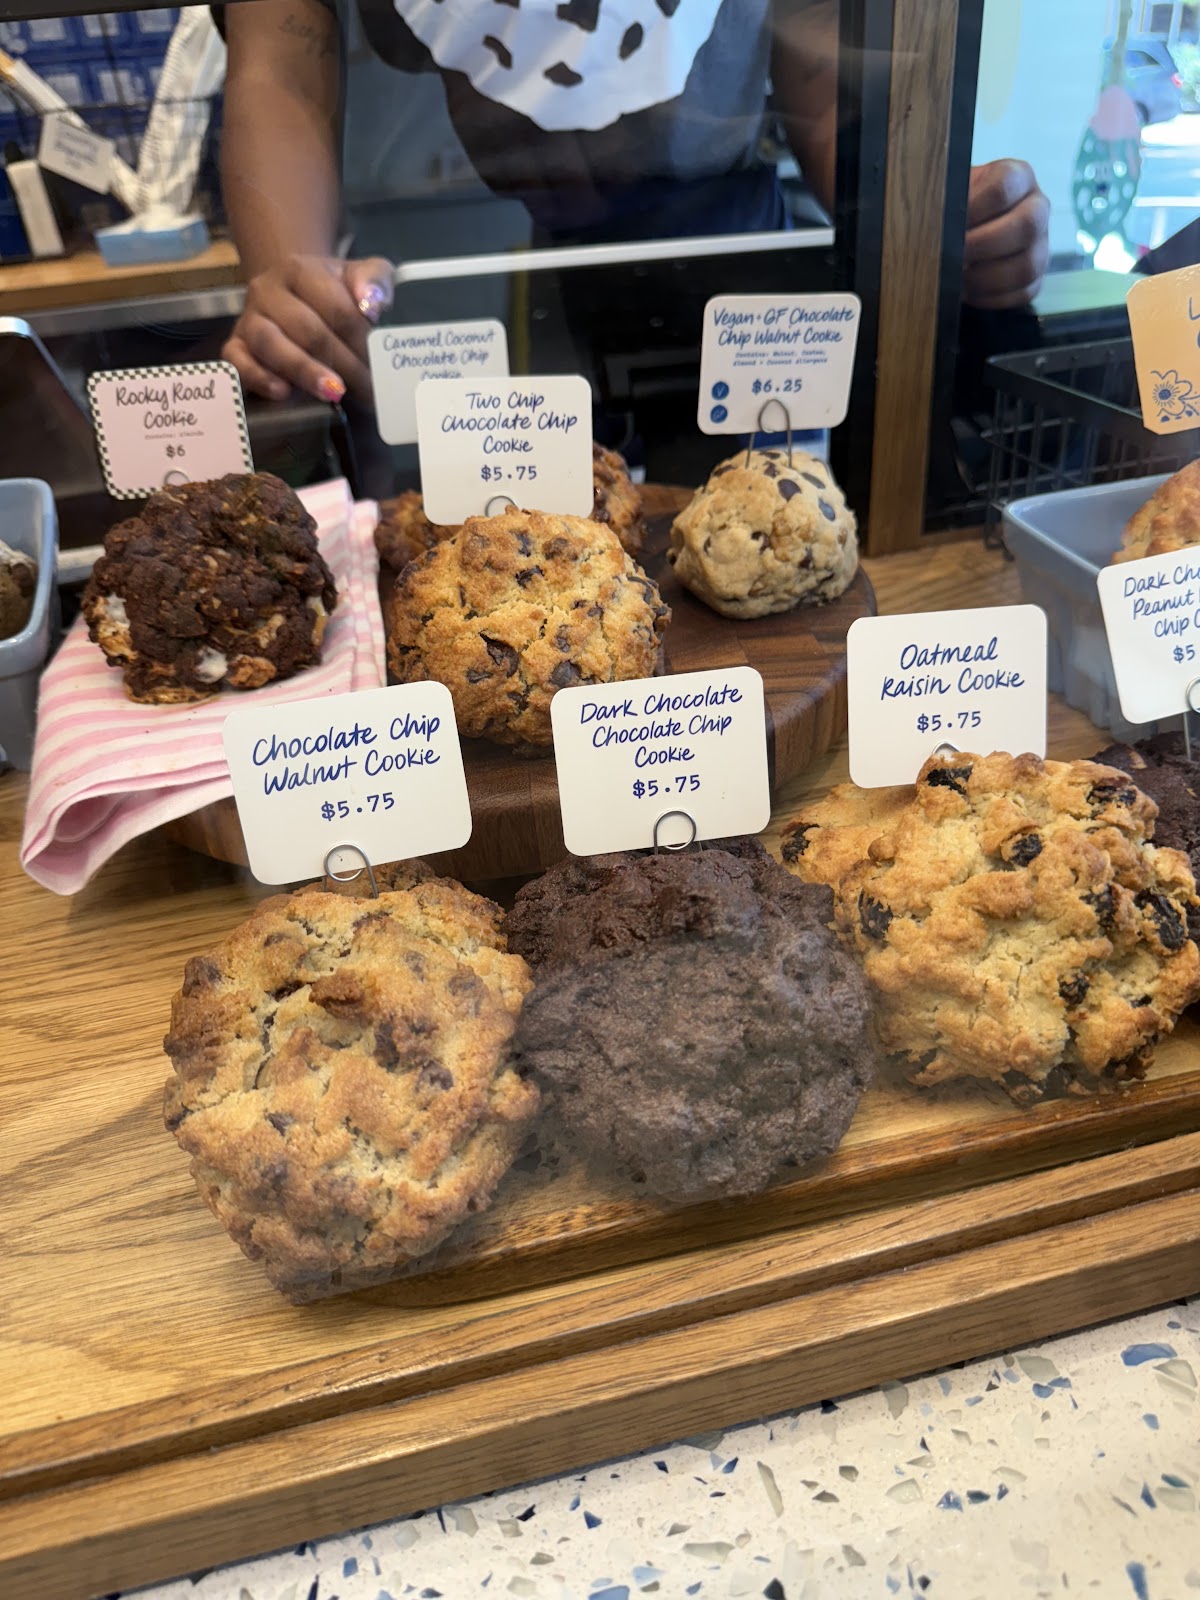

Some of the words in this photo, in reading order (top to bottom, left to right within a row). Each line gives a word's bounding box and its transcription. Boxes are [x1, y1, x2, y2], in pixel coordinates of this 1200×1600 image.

[714, 308, 754, 328] Vegan
[764, 307, 788, 325] GF
[788, 306, 854, 326] Chocolate
[382, 332, 444, 352] Caramel
[445, 327, 496, 348] Coconut
[718, 329, 751, 350] Chip
[754, 328, 801, 344] Walnut
[803, 326, 843, 344] Cookie
[392, 351, 458, 370] Chocolate
[460, 349, 490, 367] Chip
[116, 385, 169, 411] Rocky
[172, 379, 216, 403] Road
[752, 378, 803, 396] $6.25
[465, 392, 501, 410] Two
[507, 390, 545, 414] Chip
[144, 410, 198, 430] Cookie
[441, 414, 532, 433] Chocolate
[536, 412, 578, 434] Chip
[166, 444, 186, 459] $6
[482, 435, 534, 455] Cookie
[480, 464, 538, 482] $5.75
[1123, 570, 1170, 599] Dark
[1132, 588, 1195, 621] Peanut
[1154, 615, 1190, 638] Chip
[900, 636, 998, 670] Oatmeal
[880, 674, 951, 701] Raisin
[957, 667, 1025, 694] Cookie
[580, 699, 638, 725] Dark
[643, 684, 743, 716] Chocolate
[592, 717, 685, 749] Chocolate
[688, 714, 733, 737] Chip
[916, 710, 982, 734] $5.75
[252, 722, 378, 767] Chocolate
[389, 712, 441, 743] Chip
[634, 745, 696, 768] Cookie
[263, 755, 358, 796] Walnut
[364, 747, 441, 777] Cookie
[632, 774, 702, 800] $5.75
[320, 791, 396, 822] $5.75
